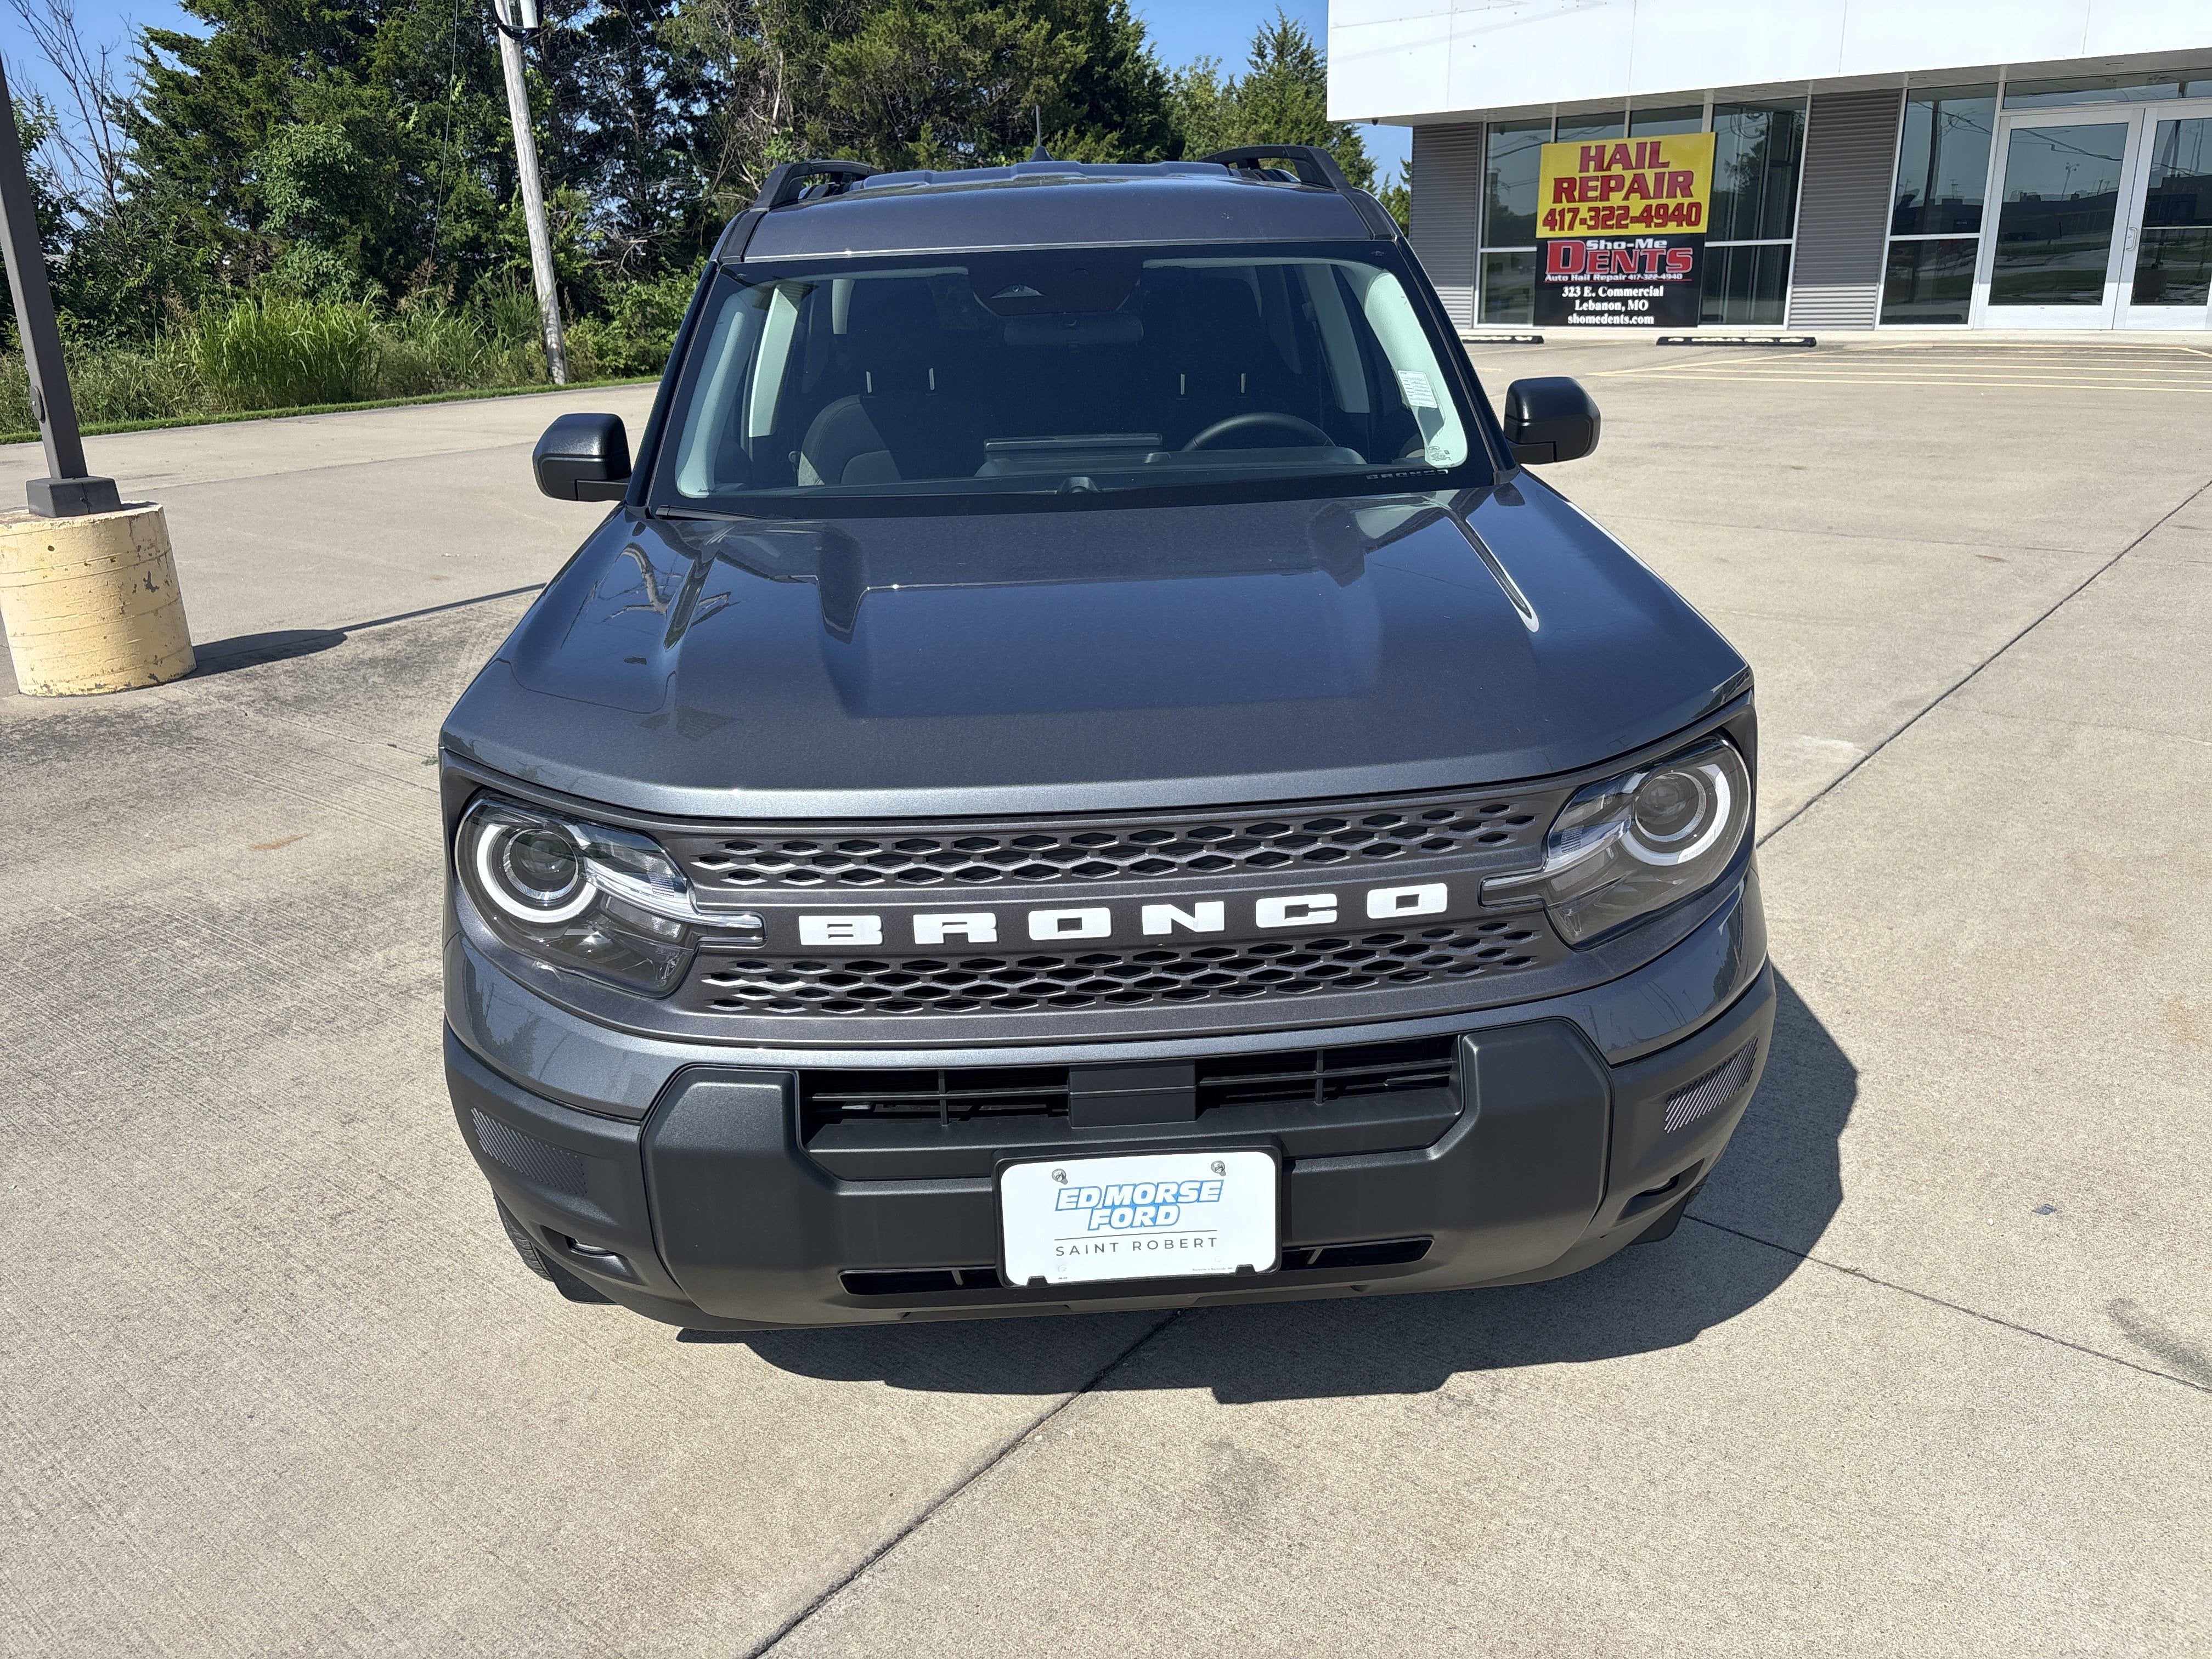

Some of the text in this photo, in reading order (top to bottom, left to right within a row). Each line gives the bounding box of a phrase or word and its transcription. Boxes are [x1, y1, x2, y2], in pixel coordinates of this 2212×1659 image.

[1579, 141, 1671, 173] HAIL
[1553, 171, 1694, 204] REPAIR
[1542, 202, 1702, 232] 417-322-4940
[1545, 240, 1694, 275] DENTS
[1586, 238, 1668, 250] Sho-Me
[1561, 285, 1664, 297] 323 E. Commercial
[1593, 273, 1627, 282] Repair
[1567, 313, 1655, 324] shomedents.com
[1575, 299, 1649, 312] Lebanon, MO
[798, 883, 1449, 946] BRONCO
[1055, 1180, 1224, 1211] ED MORSE
[1087, 1204, 1181, 1231] FORD
[1055, 1237, 1218, 1256] SAINT ROBERT
